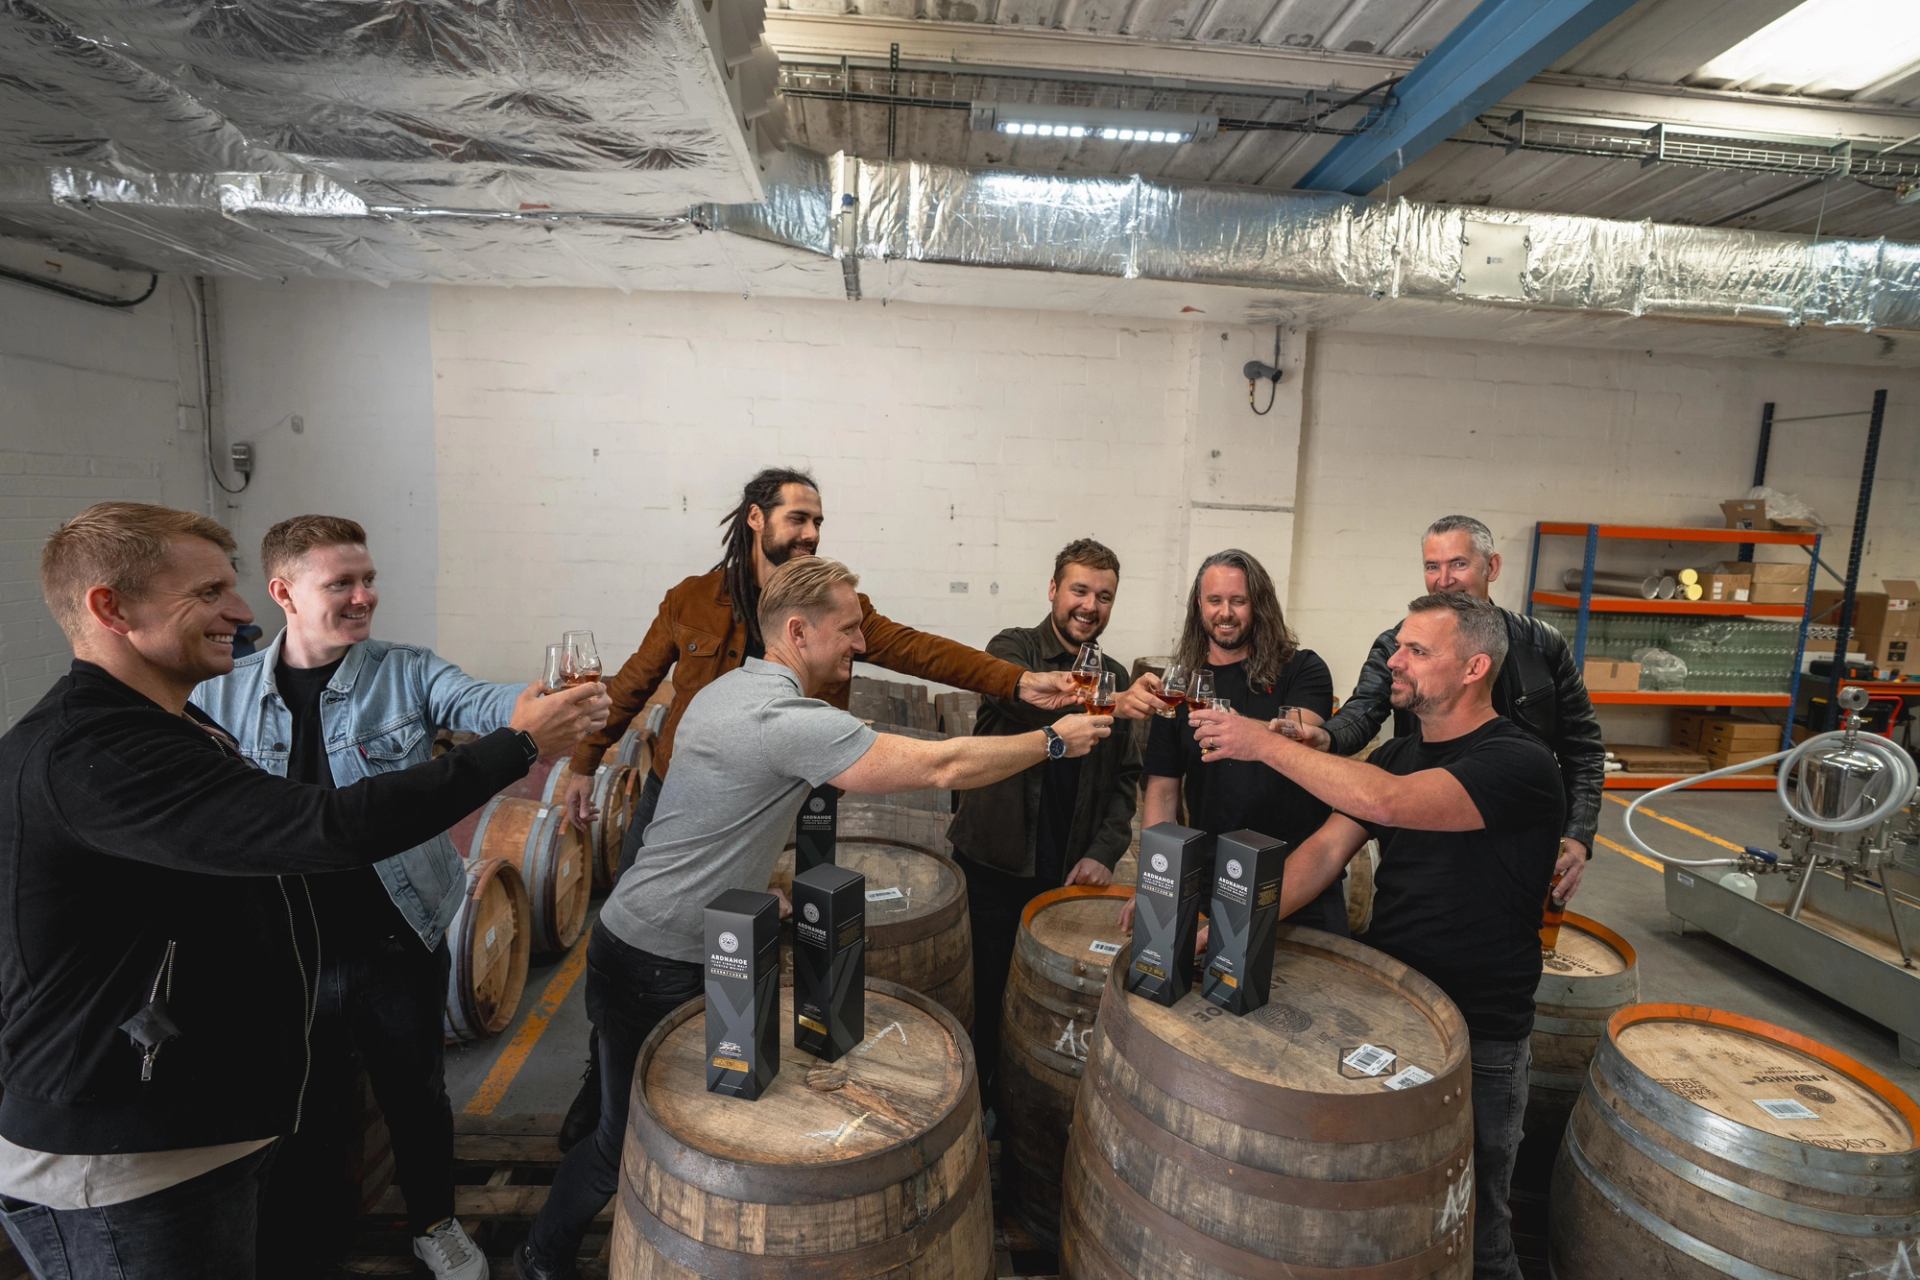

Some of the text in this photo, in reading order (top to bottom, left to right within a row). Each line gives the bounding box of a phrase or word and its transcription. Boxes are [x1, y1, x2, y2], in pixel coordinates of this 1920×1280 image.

[1143, 871, 1175, 885] ARDNAHOE
[1218, 876, 1248, 892] ARDNAHOE
[711, 953, 748, 966] ARDNAHOE
[1753, 1073, 1830, 1084] ARDNAHOE
